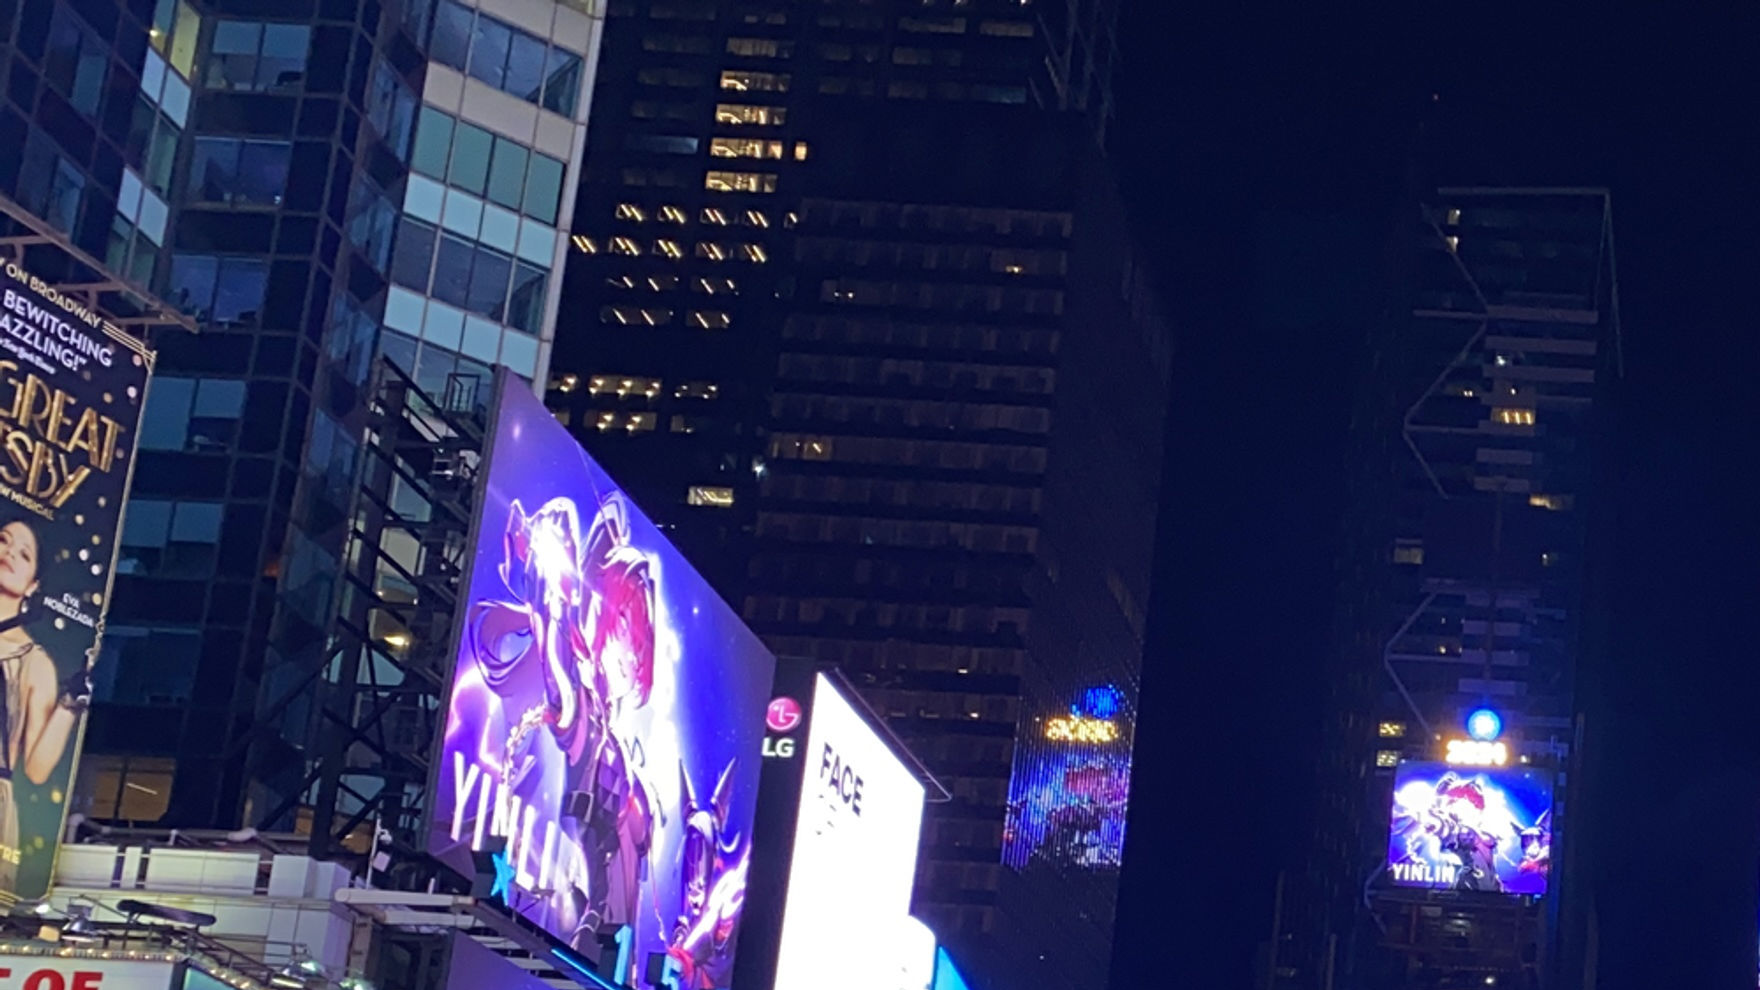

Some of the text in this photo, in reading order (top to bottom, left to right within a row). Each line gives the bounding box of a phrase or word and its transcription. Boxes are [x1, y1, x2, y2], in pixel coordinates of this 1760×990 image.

[3, 289, 113, 367] BEWITCHING
[6, 263, 102, 329] ON BROADWAY
[0, 312, 87, 372] AZZLING!"
[0, 360, 125, 473] GREAT
[0, 420, 90, 508] SBY
[11, 490, 54, 520] MUSICAL
[762, 737, 795, 758] LG
[820, 742, 864, 817] FACE
[1392, 863, 1456, 883] YINLIN
